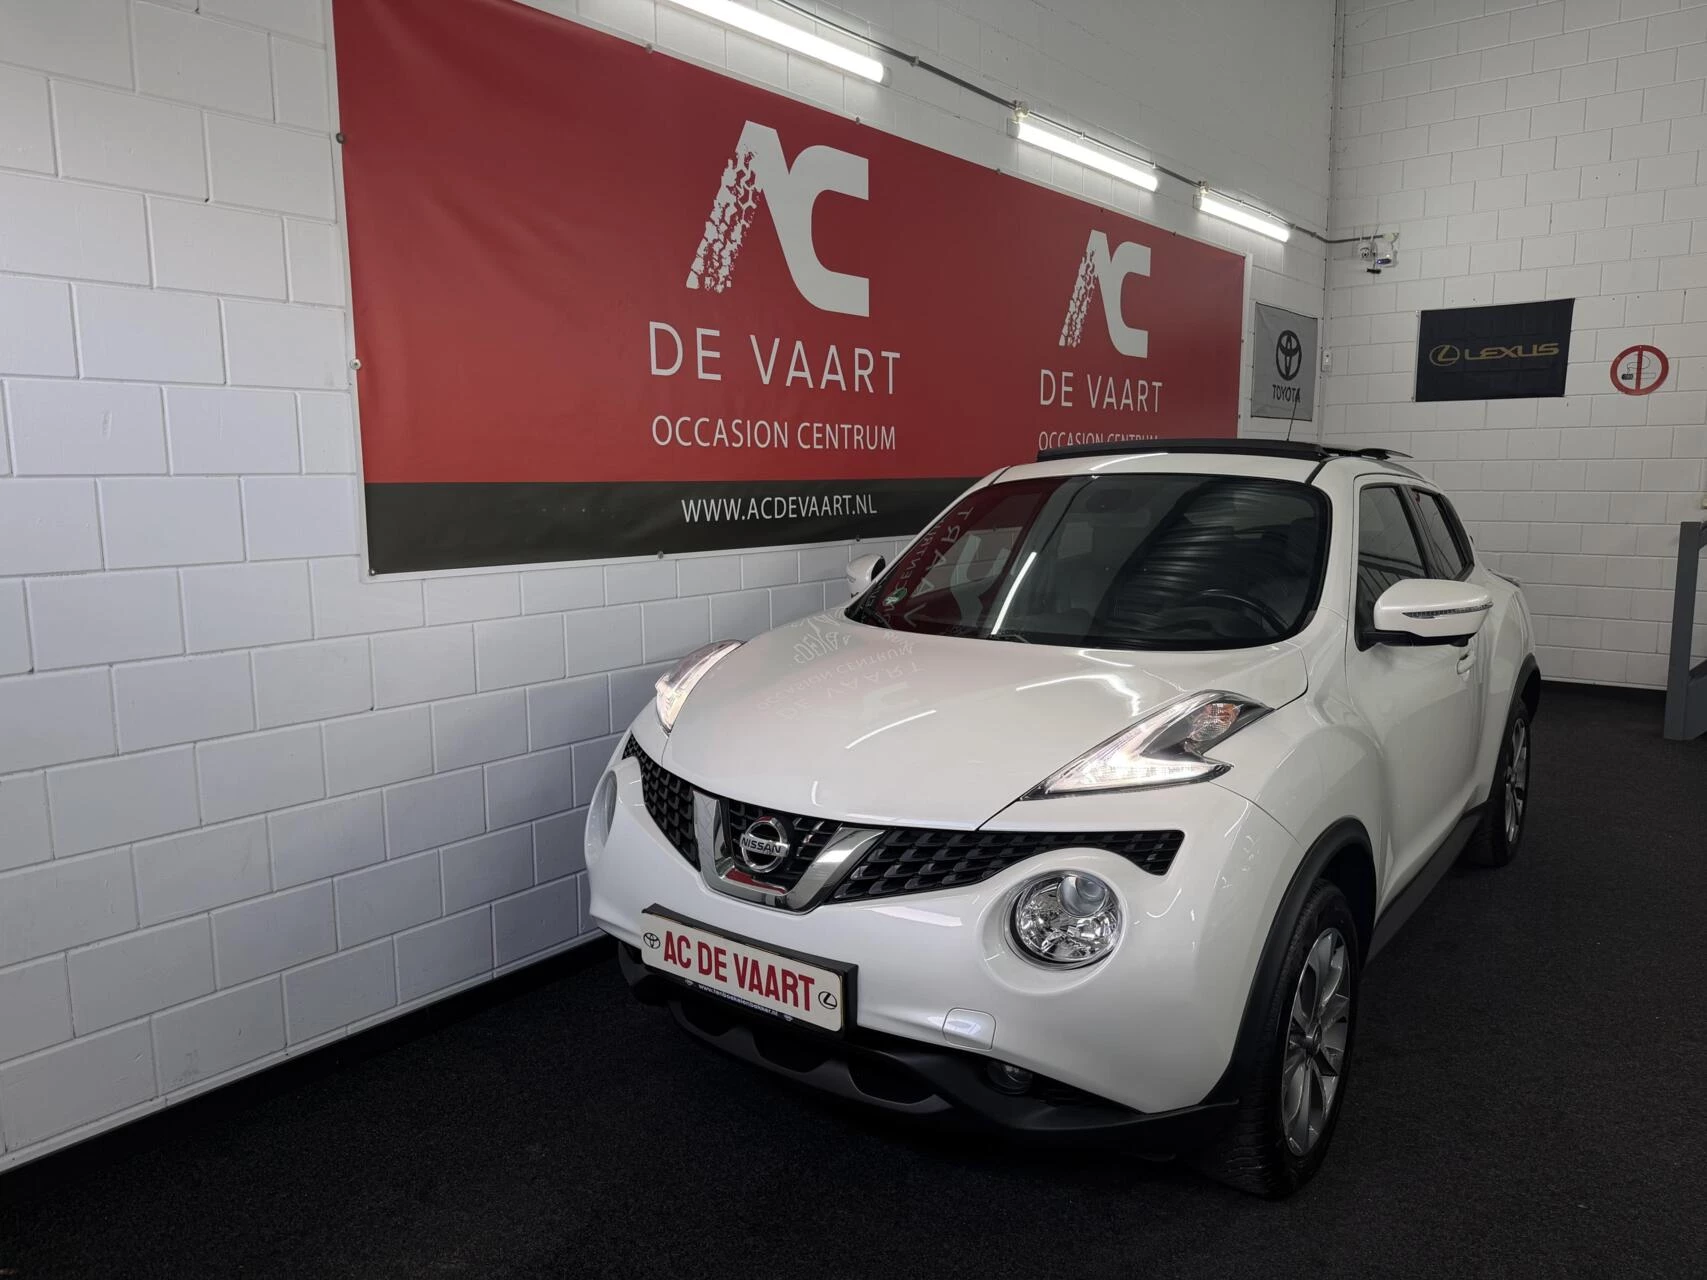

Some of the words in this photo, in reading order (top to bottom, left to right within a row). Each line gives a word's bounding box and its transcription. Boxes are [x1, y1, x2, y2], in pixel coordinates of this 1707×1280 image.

[650, 321, 721, 380] DE
[750, 334, 900, 394] VAART
[1464, 342, 1560, 361] LEXUS
[1041, 369, 1073, 406] DE
[1087, 375, 1162, 412] VAART
[1272, 384, 1301, 403] TOYOTA
[653, 415, 787, 449] OCCASION
[798, 423, 896, 450] CENTRUM
[682, 495, 877, 523] WWW.ACDEVAART.NL
[741, 836, 782, 853] NISSAN
[664, 930, 692, 969] AC
[697, 941, 728, 983] DE
[733, 952, 815, 1012] VAART
